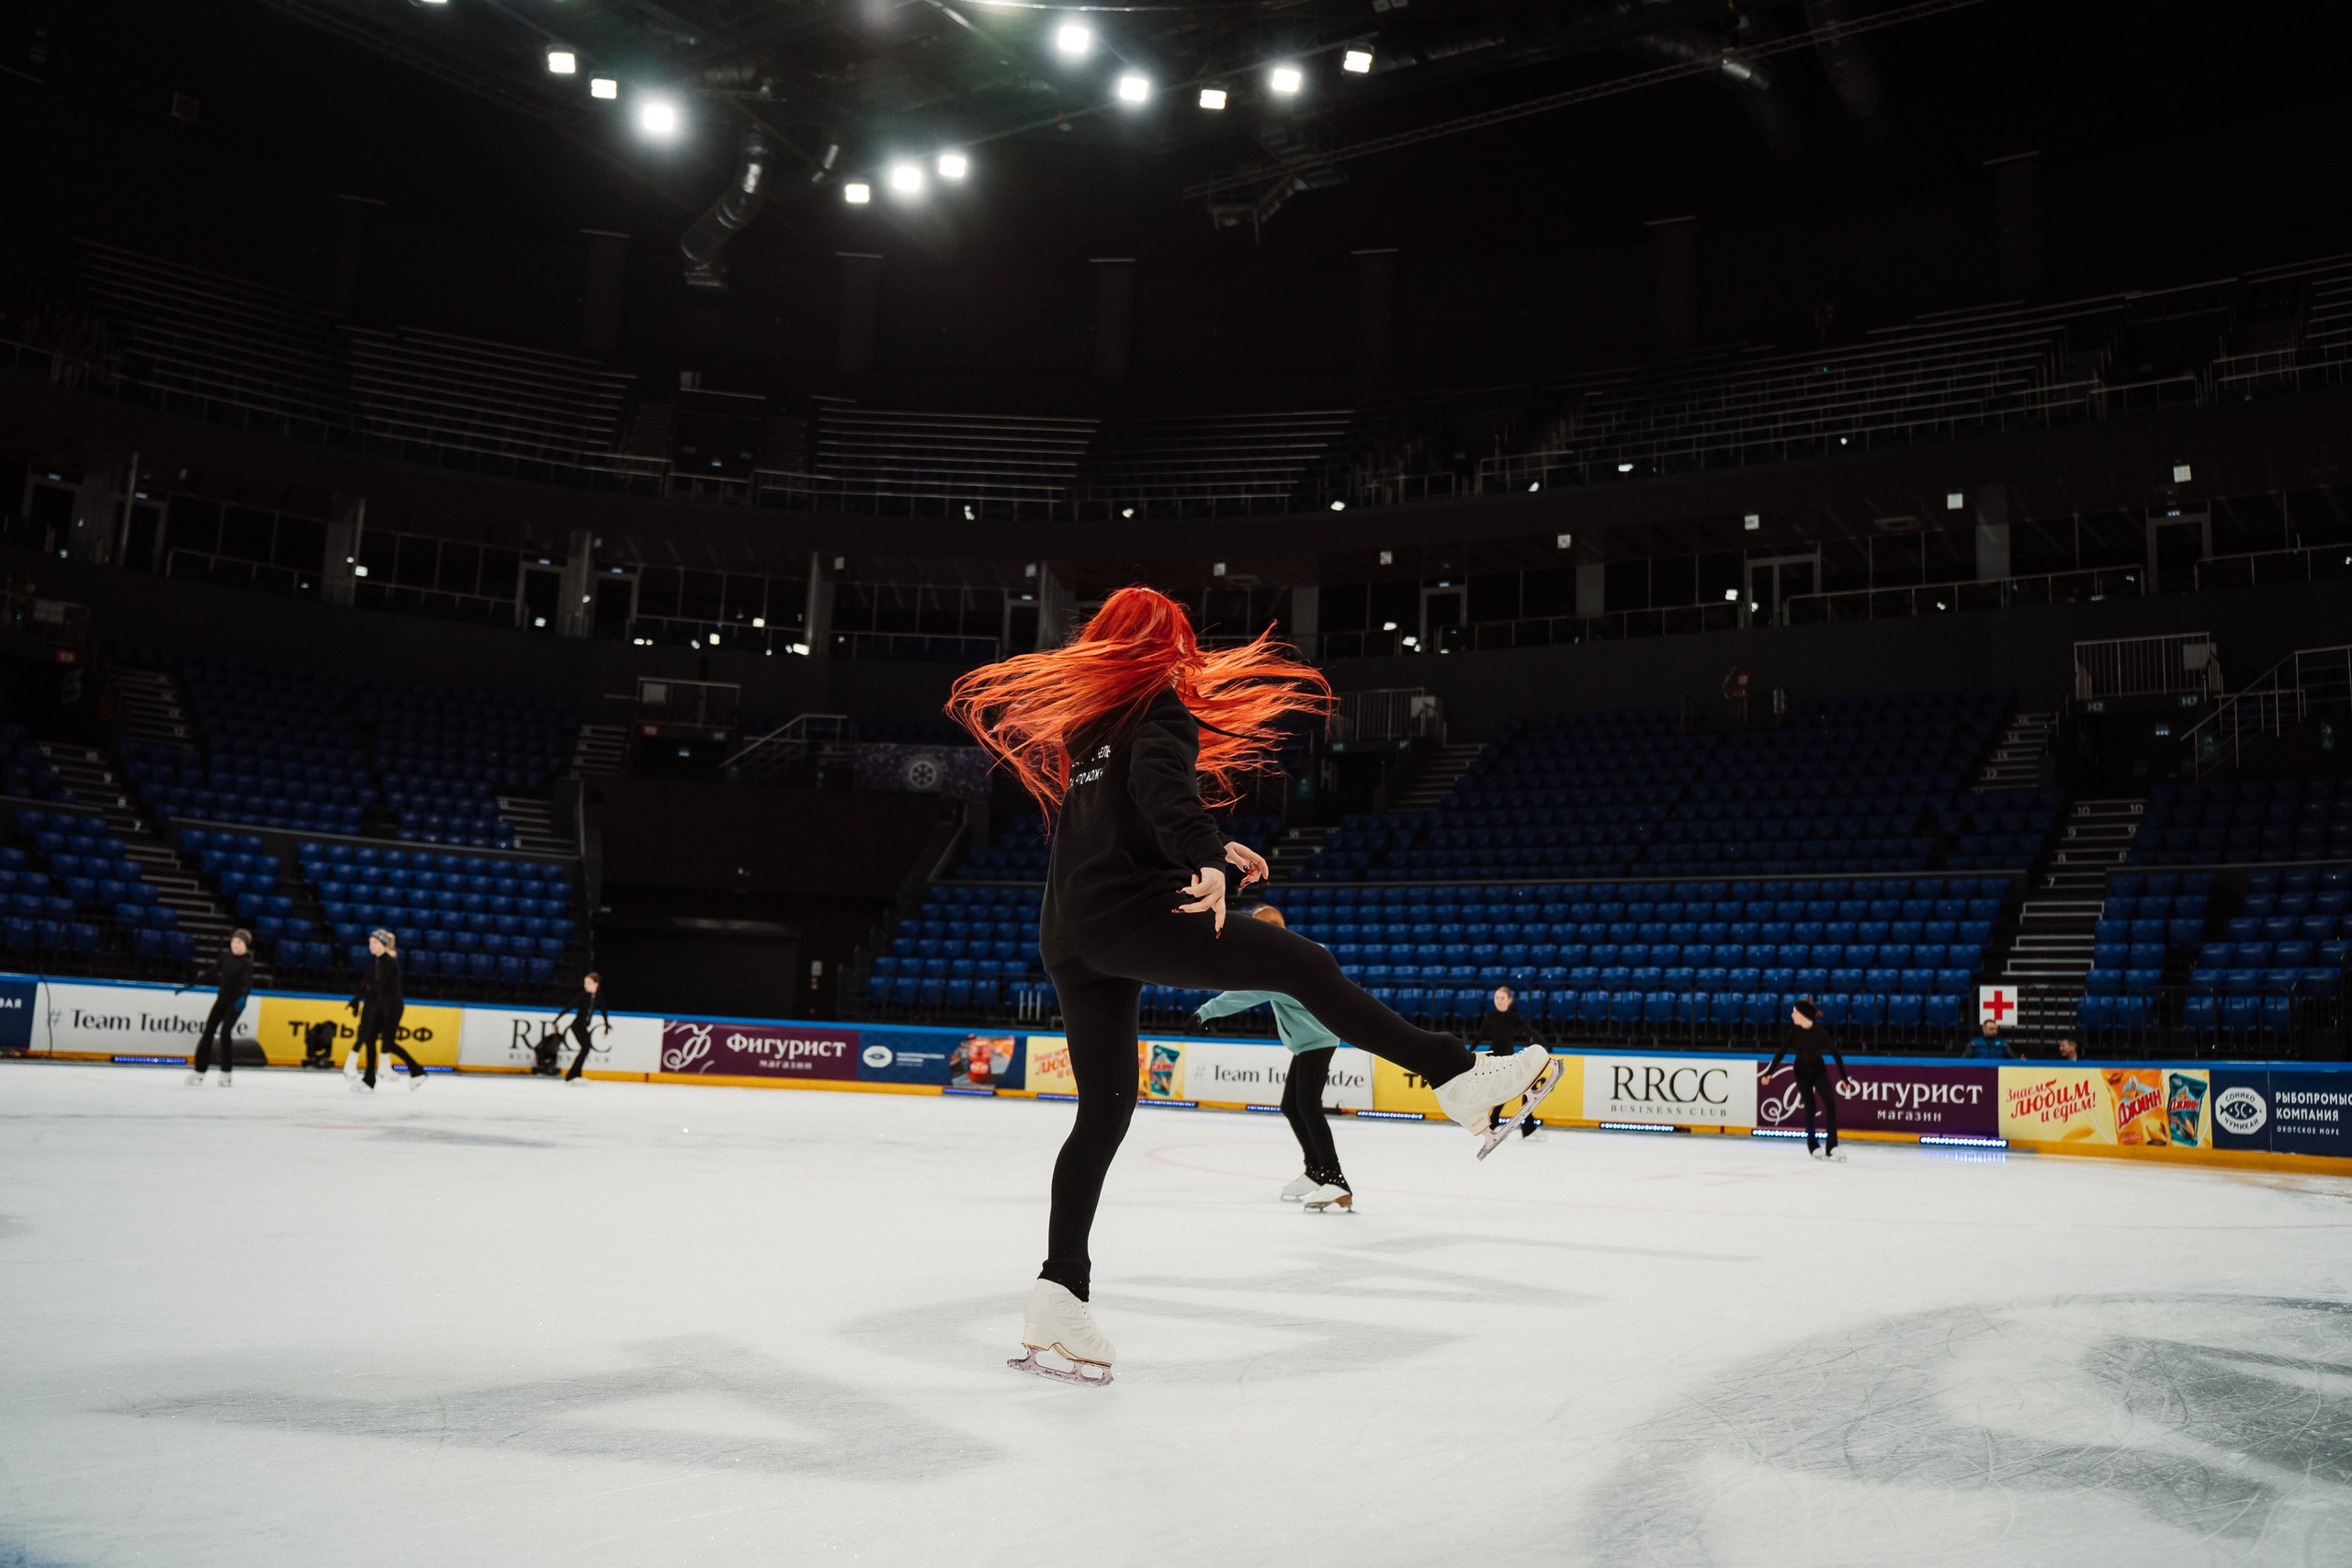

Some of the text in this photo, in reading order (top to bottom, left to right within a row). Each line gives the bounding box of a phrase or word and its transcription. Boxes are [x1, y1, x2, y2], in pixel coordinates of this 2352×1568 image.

[71, 1009, 130, 1031] Team
[726, 1032, 846, 1060] Фигурист
[1213, 1064, 1260, 1082] Team
[1610, 1066, 1729, 1105] RRCC
[1835, 1076, 1984, 1110] Фигурист
[2225, 1092, 2256, 1103] СОНИКО
[1611, 1105, 1727, 1117] BUSINESS CLUB
[1877, 1109, 1942, 1122] магазин
[2041, 1091, 2097, 1124] и едим!
[2276, 1107, 2339, 1122] КОМПАНИЯ
[2277, 1125, 2339, 1136] ОХОТСКОЕ МОРЕ
